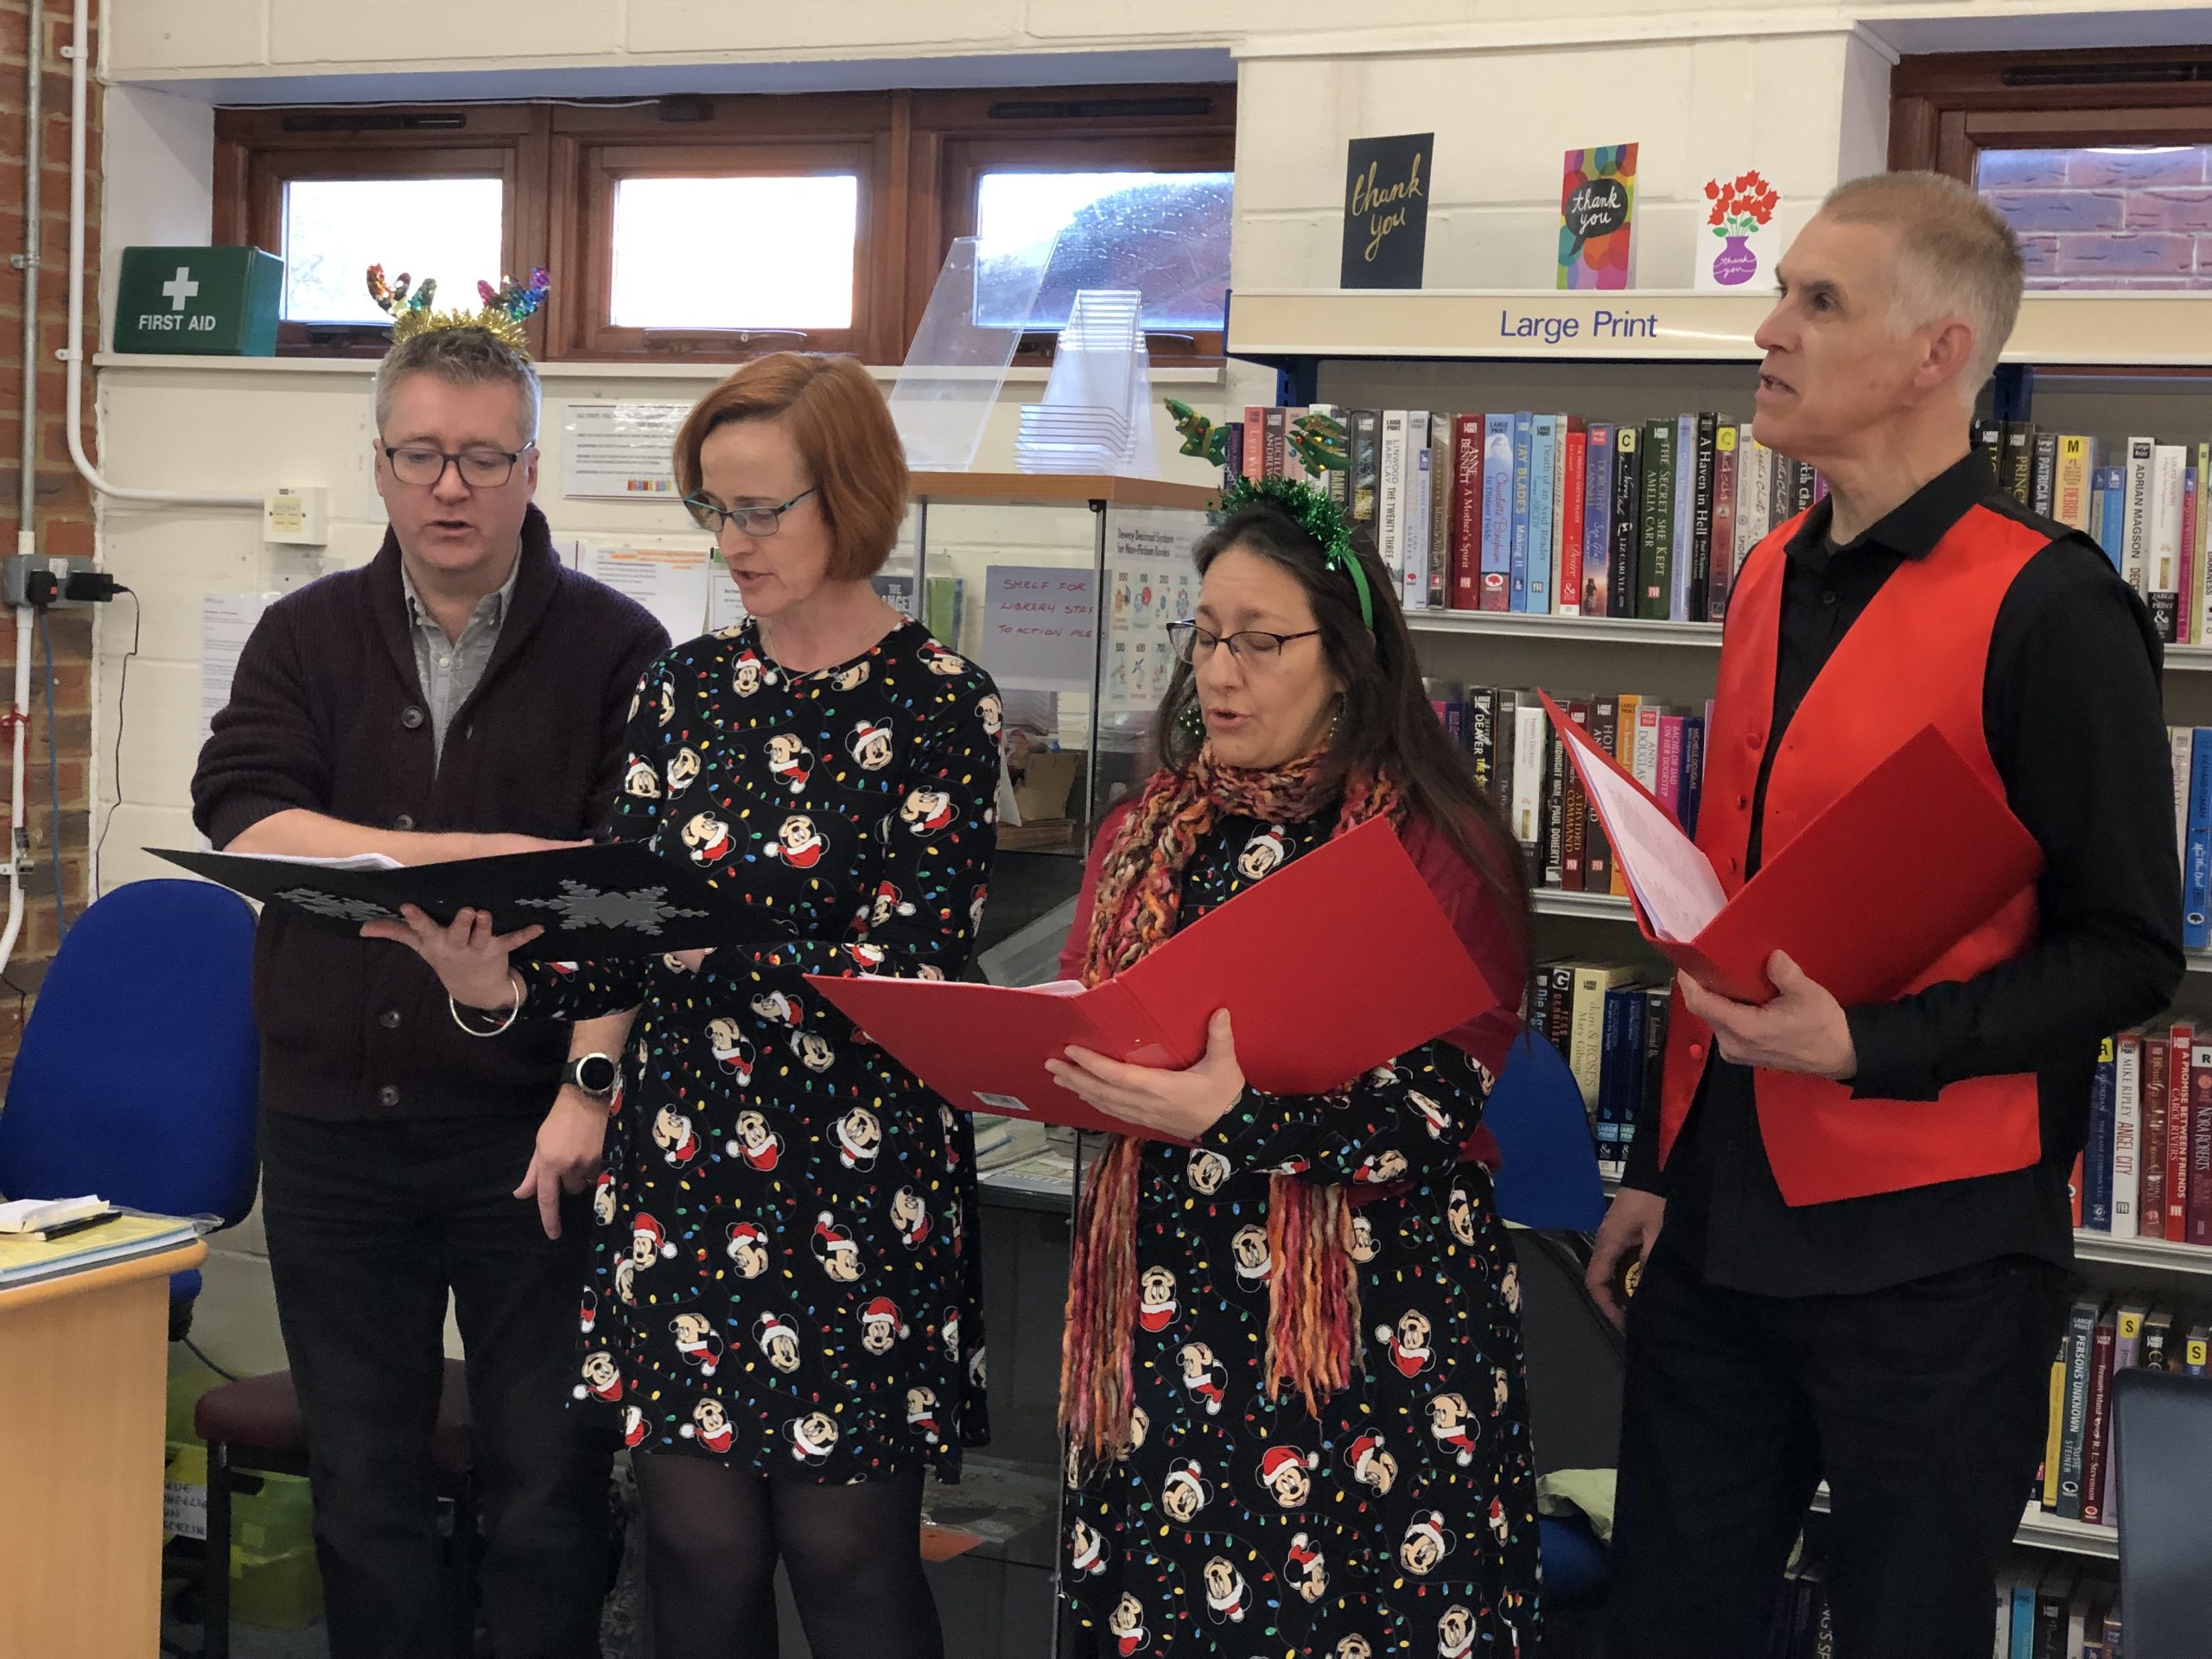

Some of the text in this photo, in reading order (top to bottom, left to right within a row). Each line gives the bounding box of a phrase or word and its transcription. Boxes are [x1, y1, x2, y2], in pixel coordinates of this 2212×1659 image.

[1352, 153, 1424, 215] thank
[1572, 179, 1621, 213] thank
[1364, 207, 1406, 262] you
[1580, 210, 1612, 234] you
[1720, 254, 1748, 265] thank
[1723, 266, 1742, 278] you
[138, 315, 216, 331] FIRST AID
[1501, 311, 1657, 343] Large Print
[1517, 442, 1528, 463] JAY
[1622, 435, 1630, 447] C
[2067, 441, 2079, 453] M
[1459, 438, 1470, 485] BENNETT
[1469, 446, 1478, 476] ANNE
[2037, 457, 2050, 499] PATRICIA
[1332, 471, 1344, 502] BANKS
[1516, 467, 1527, 514] BLADES
[1596, 461, 1606, 512] DOROTHY
[1696, 437, 1710, 536] A Haven in Hell
[2170, 456, 2178, 506] Laura Martin
[1463, 499, 1471, 540] Mother's
[1539, 444, 1552, 562] Death of an Avid Reader
[1644, 470, 1656, 547] AMELIA CARR
[1656, 442, 1670, 575] THE SECRET SHE KEPT
[2063, 487, 2078, 520] DEBBIE
[2131, 464, 2145, 559] ADRIAN MAGSON
[1118, 528, 1174, 544] Dewey Decimal System
[1385, 487, 1395, 558] THE TWENTY-THREE
[1126, 543, 1154, 556] Non-Fiction
[1155, 547, 1170, 557] Books
[1460, 544, 1470, 569] Spirit
[1515, 525, 1524, 557] Making
[1569, 543, 1580, 577] Desire
[1004, 579, 1086, 591] SHELF FOR
[1000, 602, 1056, 613] LIBRARY
[998, 625, 1064, 637] TO ACTION
[1474, 714, 1484, 754] DEAVER
[1663, 726, 1670, 737] ON
[1553, 741, 1562, 796] MIDNIGHT MAN
[1637, 730, 1648, 780] DOUGLAS
[1669, 726, 1680, 785] BACHELOR DAD
[2173, 753, 2185, 785] Joseph
[1661, 757, 1669, 797] DOORSTEP
[2197, 788, 2207, 818] OSMAN
[1551, 805, 1561, 864] PAUL DOHERTY
[1565, 790, 1575, 853] COMMAND
[1535, 989, 1548, 1008] Die
[1560, 1010, 1568, 1035] TESS
[1586, 1031, 1598, 1039] &
[1574, 1012, 1586, 1075] Mary Gibson
[2202, 1054, 2211, 1064] R
[1585, 1045, 1598, 1087] ROSES
[2180, 1061, 2189, 1103] PROMISE
[2120, 1058, 2133, 1117] MIKE RIPLEY
[2178, 1106, 2188, 1154] BETWEEN
[2196, 1107, 2212, 1133] NORA
[2115, 1122, 2133, 1176] ANGEL CITY
[2170, 1126, 2179, 1161] RIVERS
[2195, 1134, 2210, 1171] ROBERTS
[2177, 1157, 2186, 1198] FRIENDS
[2126, 1320, 2134, 1332] S
[2191, 1346, 2202, 1359] S
[2069, 1335, 2085, 1433] PERSONS UNKNOWN
[2097, 1364, 2106, 1392] Treasure
[2063, 1440, 2074, 1472] STEINER
[2072, 1446, 2081, 1468] SUSIE
[2092, 1440, 2100, 1449] R.
[2088, 1463, 2099, 1501] Stevenson
